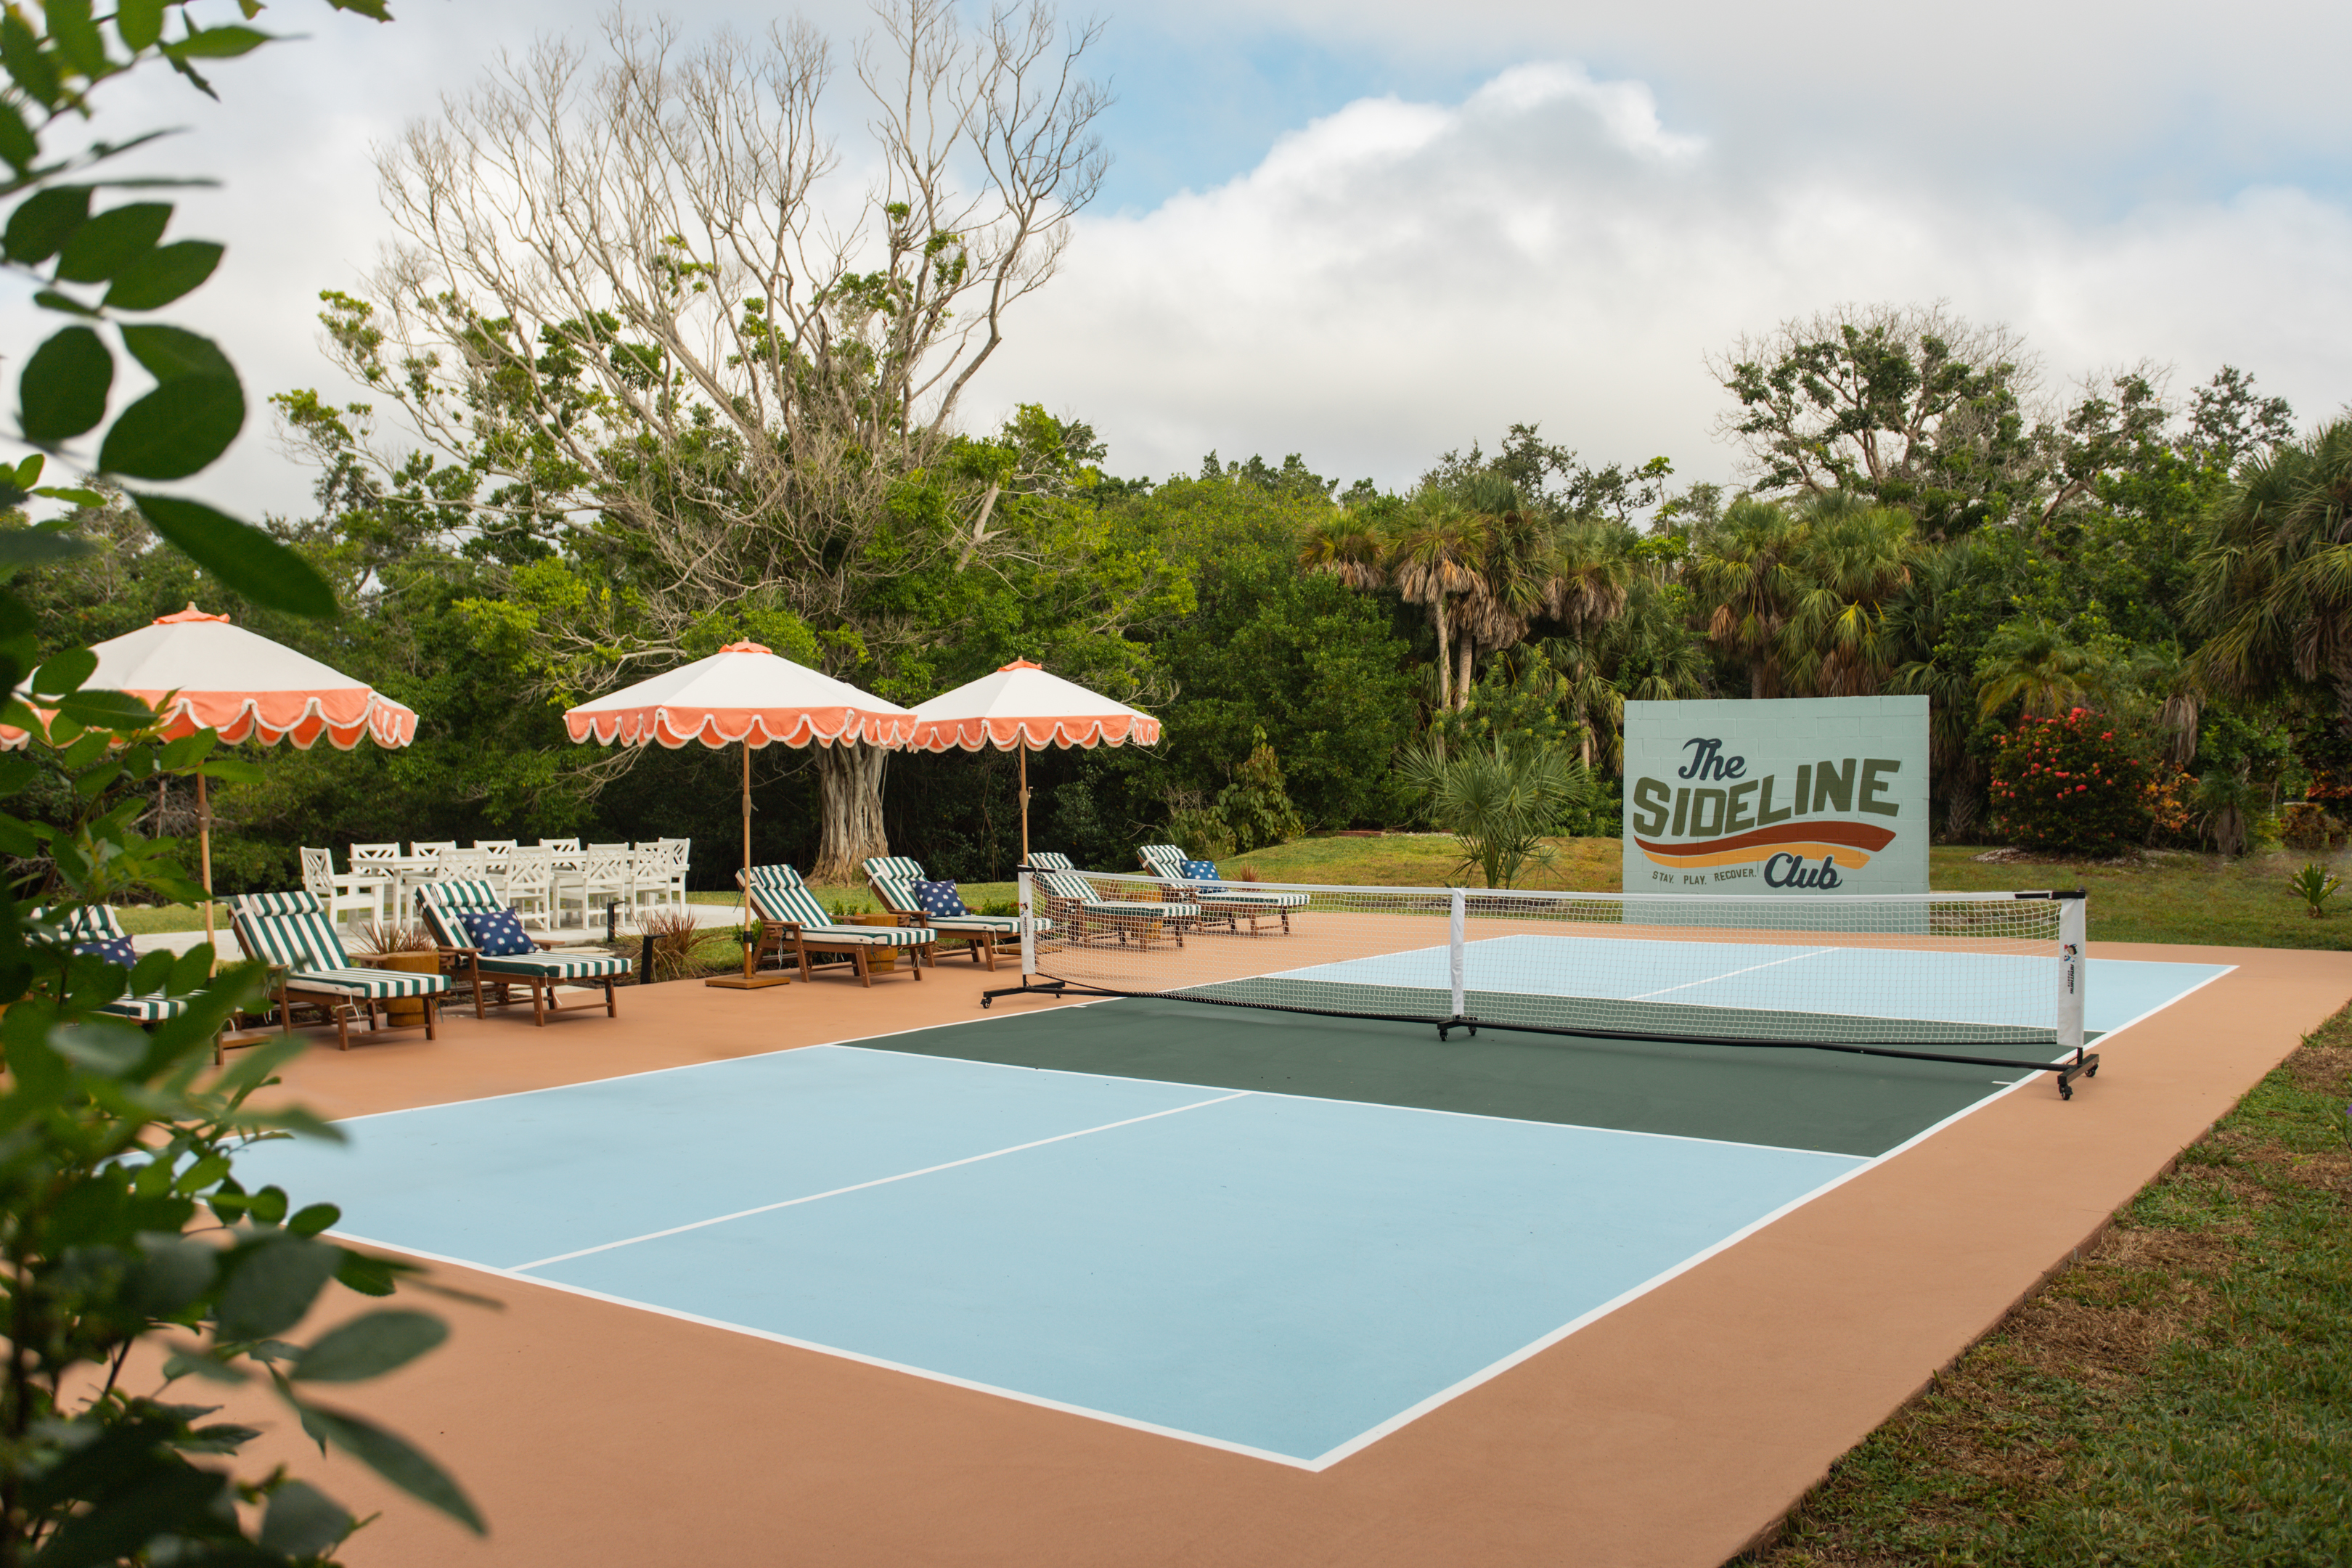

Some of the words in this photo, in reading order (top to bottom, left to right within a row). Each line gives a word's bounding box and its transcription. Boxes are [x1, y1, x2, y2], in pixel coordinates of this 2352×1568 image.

[1678, 738, 1747, 781] The
[1633, 758, 1901, 838] SIDELINE
[1652, 870, 1674, 884] STAY.
[1683, 875, 1707, 885] PLAY.
[1714, 868, 1757, 882] RECOVER.
[1764, 852, 1842, 890] Club
